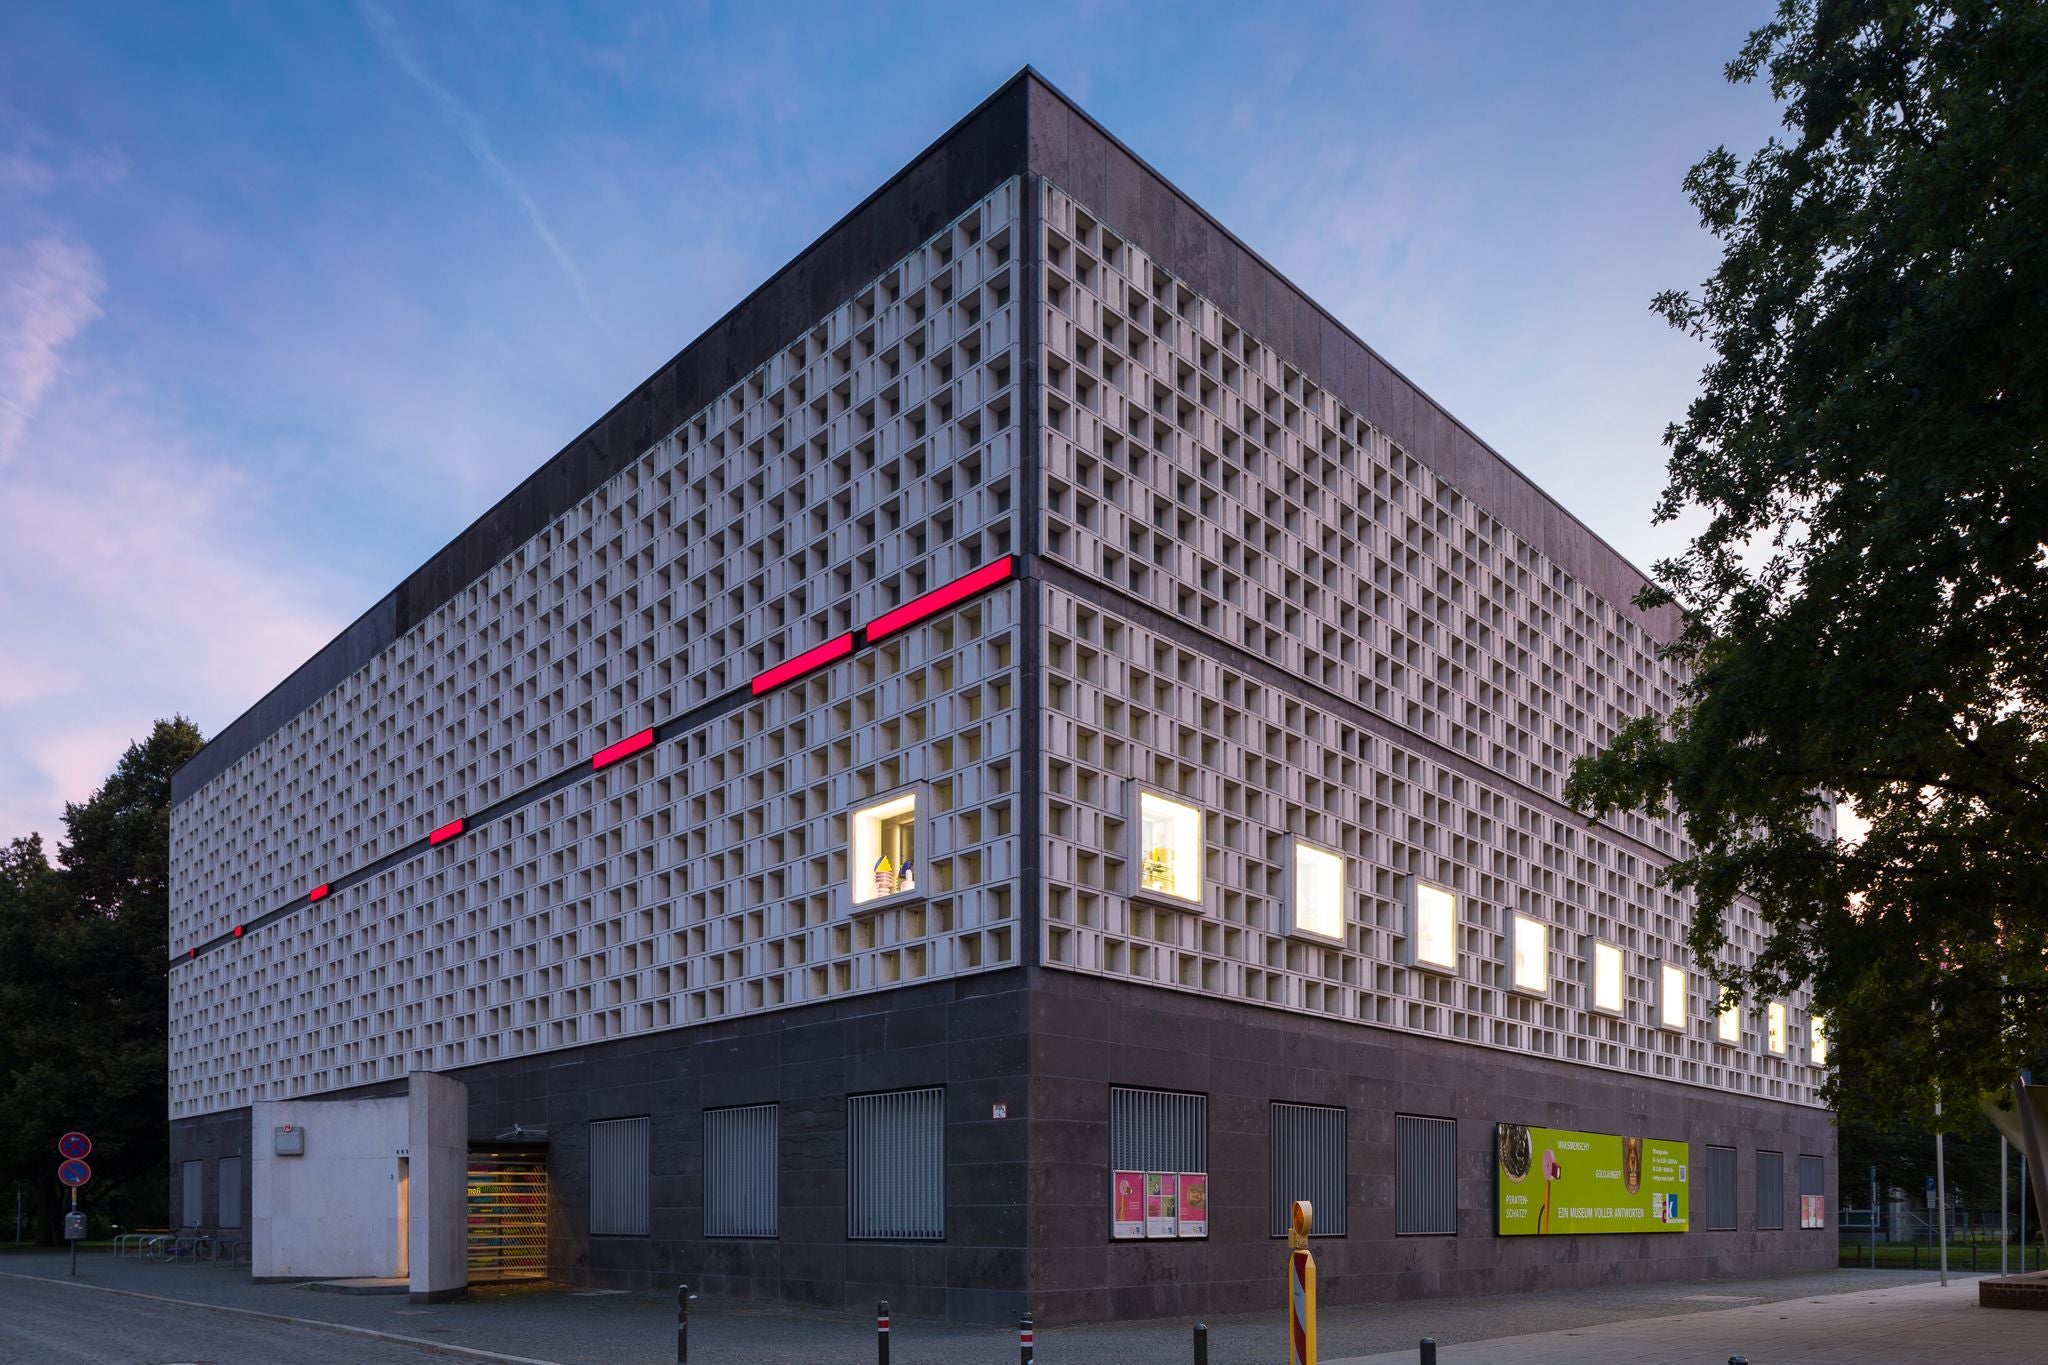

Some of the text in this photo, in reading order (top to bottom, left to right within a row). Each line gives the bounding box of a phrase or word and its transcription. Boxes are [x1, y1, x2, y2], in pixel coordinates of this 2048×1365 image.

[1557, 1140, 1590, 1151] MARSMENSCH?
[1928, 1178, 1934, 1189] P
[1506, 1195, 1529, 1205] PIRATEN-
[1506, 1209, 1527, 1218] SCHATZ?
[1558, 1207, 1645, 1219] EIN MUSEUM VOLLER ANTWORTEN
